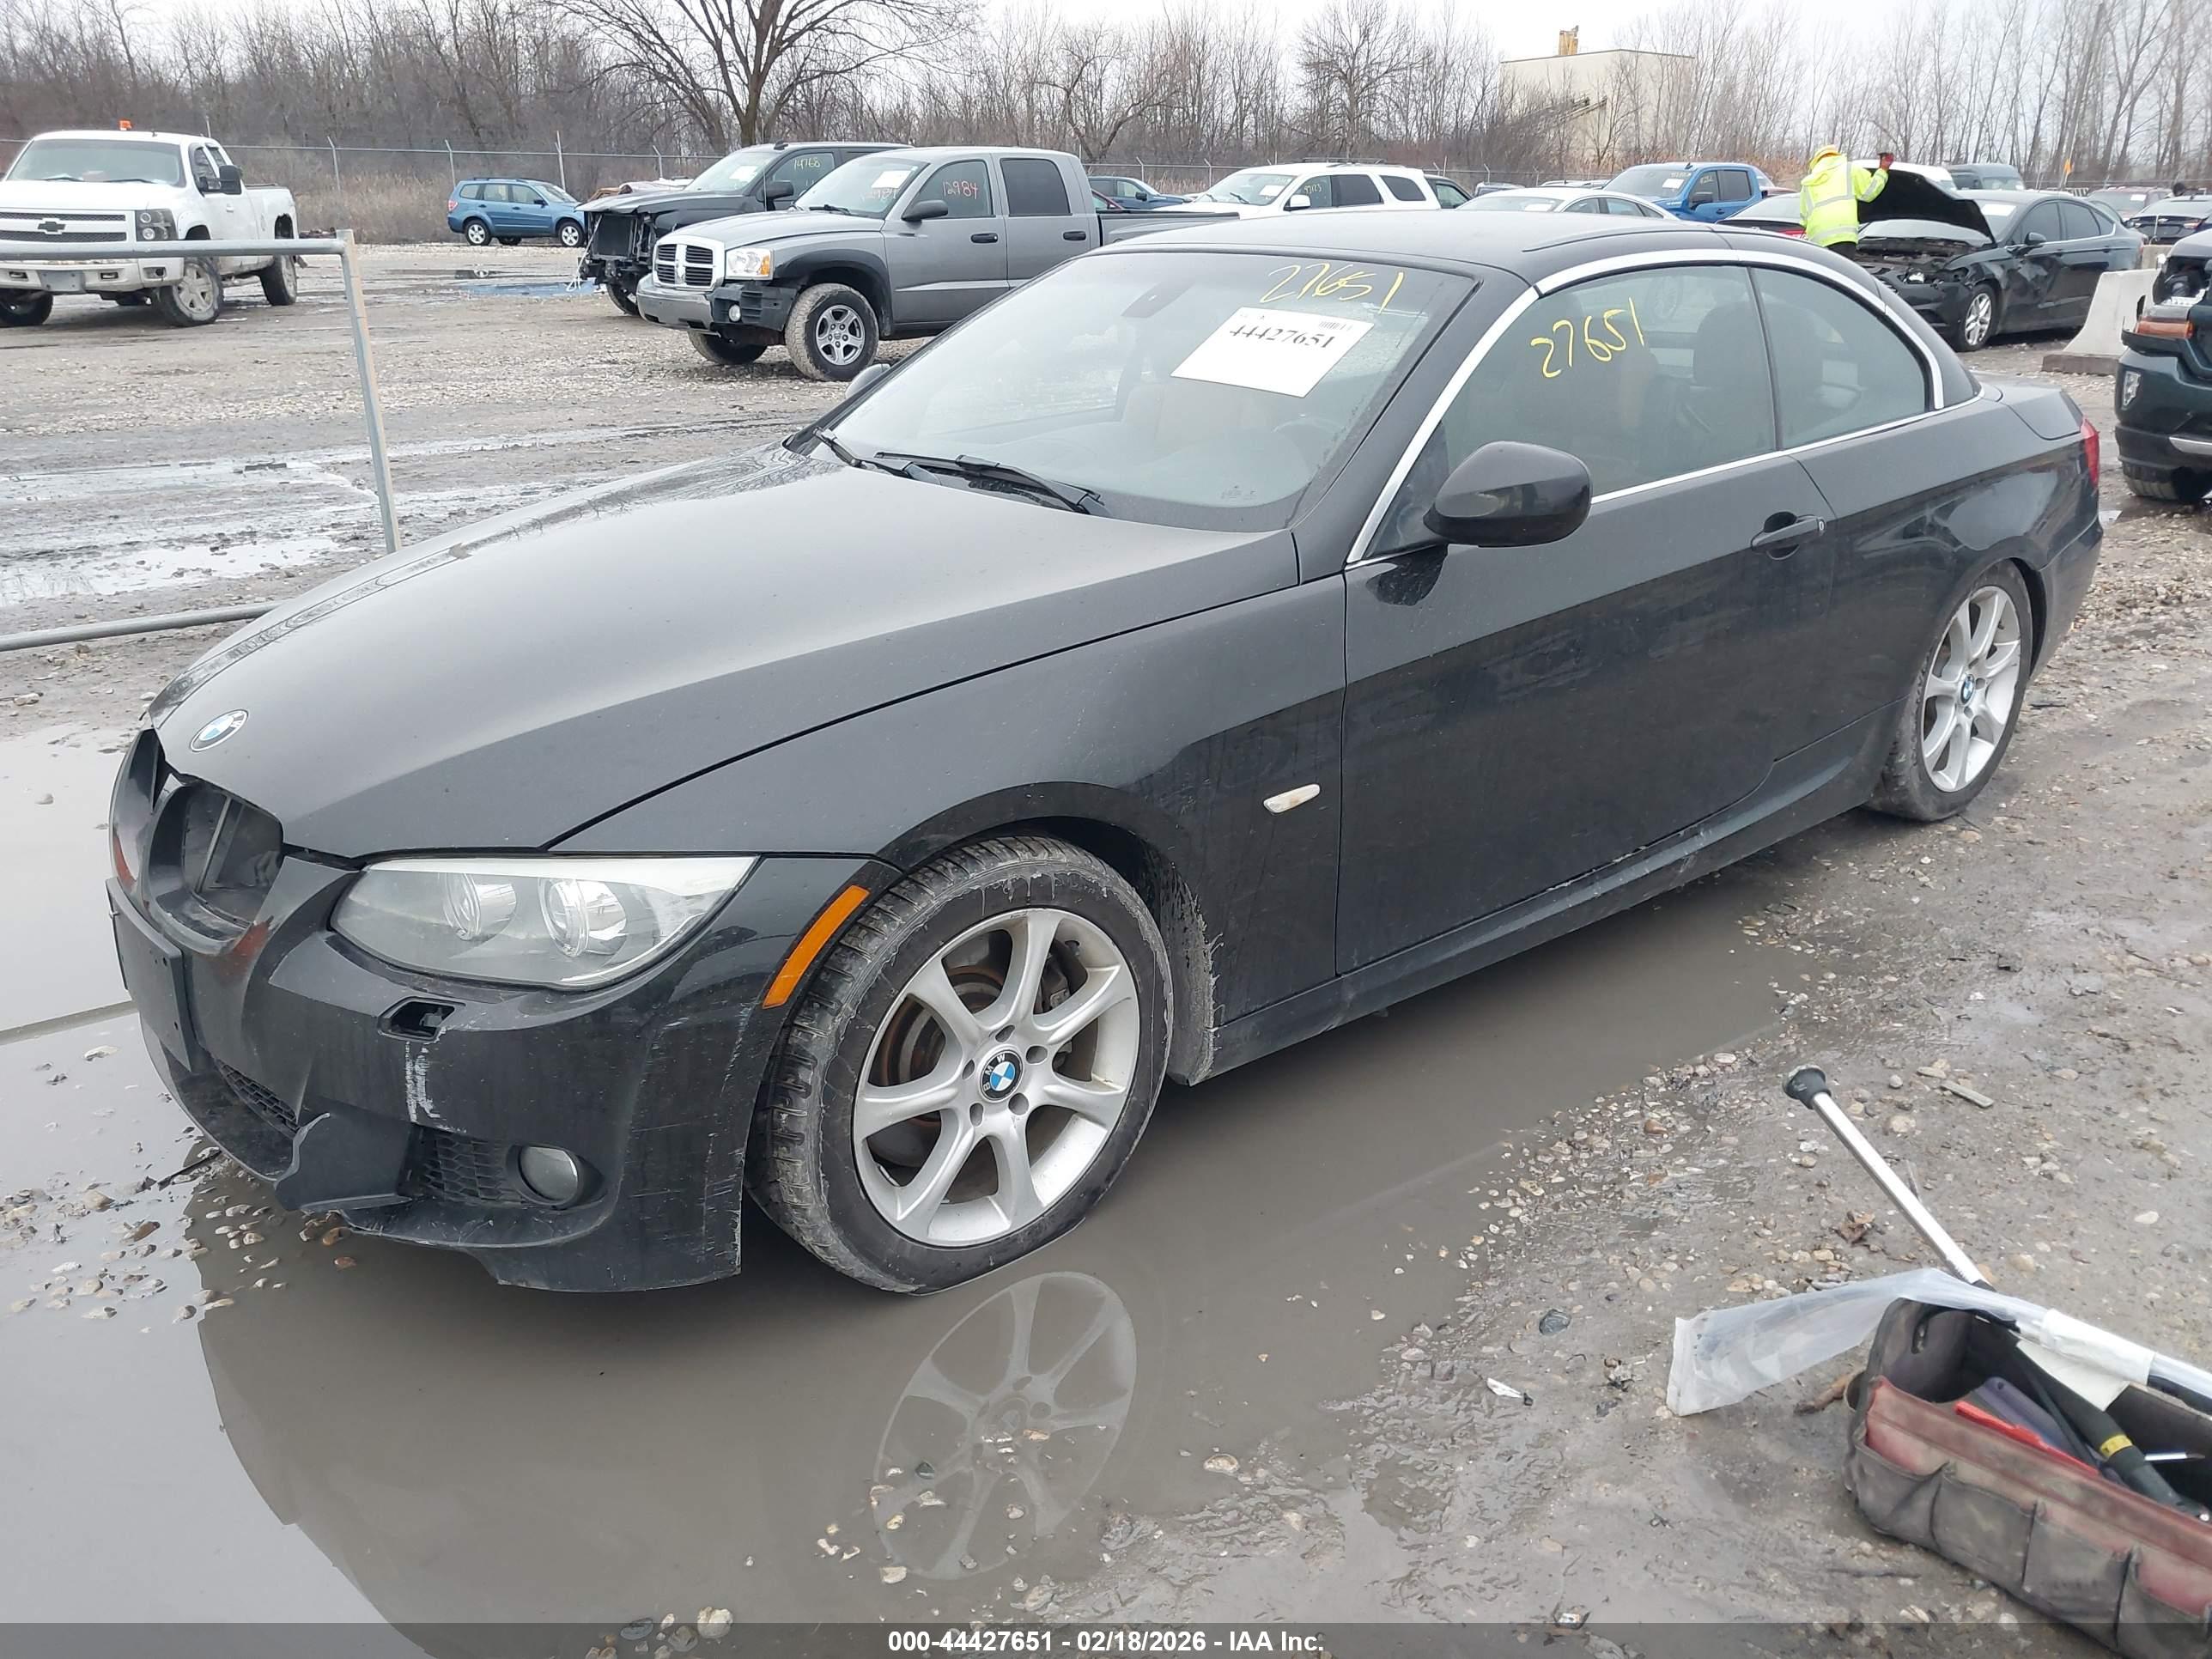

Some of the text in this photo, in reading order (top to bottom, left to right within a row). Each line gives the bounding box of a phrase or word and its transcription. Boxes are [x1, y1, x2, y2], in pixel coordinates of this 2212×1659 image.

[942, 180, 978, 200] 12984
[1259, 262, 1405, 315] 27651
[1230, 325, 1336, 349] 44427651
[1530, 296, 1645, 378] 27651
[982, 1053, 1006, 1091] BMW
